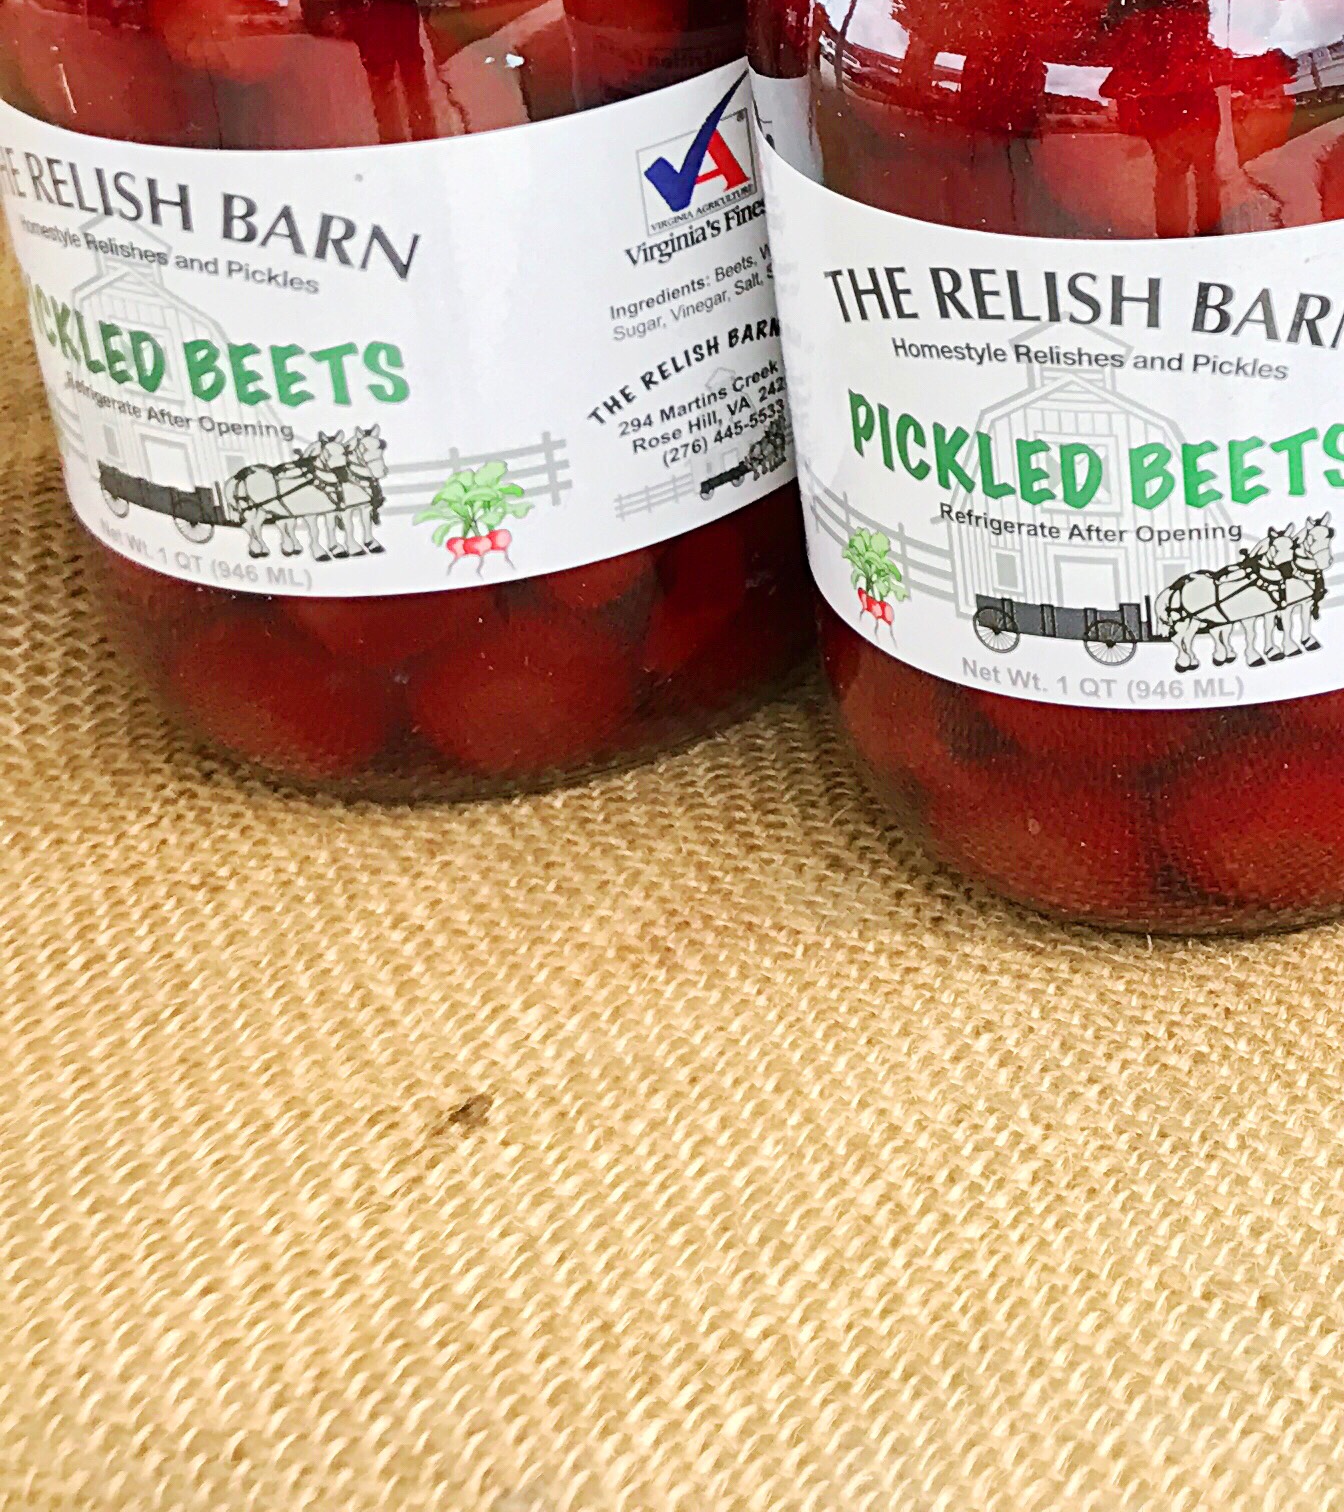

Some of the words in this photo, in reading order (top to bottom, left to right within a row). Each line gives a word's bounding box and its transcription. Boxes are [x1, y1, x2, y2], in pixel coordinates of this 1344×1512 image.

[24, 151, 195, 233] RELISH
[221, 191, 422, 281] BARN
[624, 219, 721, 266] Virginia's
[83, 231, 169, 266] Relishes
[175, 252, 220, 276] and
[228, 261, 321, 295] Pickles
[609, 275, 711, 321] Ingredients:
[612, 315, 668, 342] Sugar,
[670, 288, 732, 322] Vinegar,
[733, 272, 764, 297] Salt,
[823, 266, 920, 324] THE
[928, 266, 1163, 329] RELISH
[182, 338, 411, 409] BEETS
[586, 384, 638, 427] THE
[640, 335, 721, 391] RELISH
[727, 317, 781, 349] BARN
[891, 336, 1008, 367] Homestyle
[1014, 343, 1125, 369] Relishes
[1132, 349, 1185, 374] and
[1193, 352, 1290, 382] Pickles
[147, 405, 193, 429] After
[199, 416, 294, 441] Opening
[618, 413, 654, 438] 294
[659, 387, 728, 423] Martins
[732, 359, 779, 393] Creek
[631, 427, 683, 454] Rose
[687, 409, 724, 434] Hill,
[726, 396, 751, 416] VA
[662, 436, 709, 469] (276)
[713, 398, 786, 444] 445-5533
[847, 387, 1104, 511] PICKLED
[939, 502, 1062, 541] Refrigerate
[1067, 523, 1126, 543] After
[1135, 522, 1243, 546] Opening
[175, 551, 203, 572] QT
[267, 566, 313, 590] ML)
[961, 657, 1003, 684] Net
[1006, 667, 1048, 694] Wt.
[1057, 676, 1071, 697] 1
[1079, 677, 1118, 700] QT
[1126, 677, 1186, 704] (946
[1192, 675, 1245, 702] ML)
